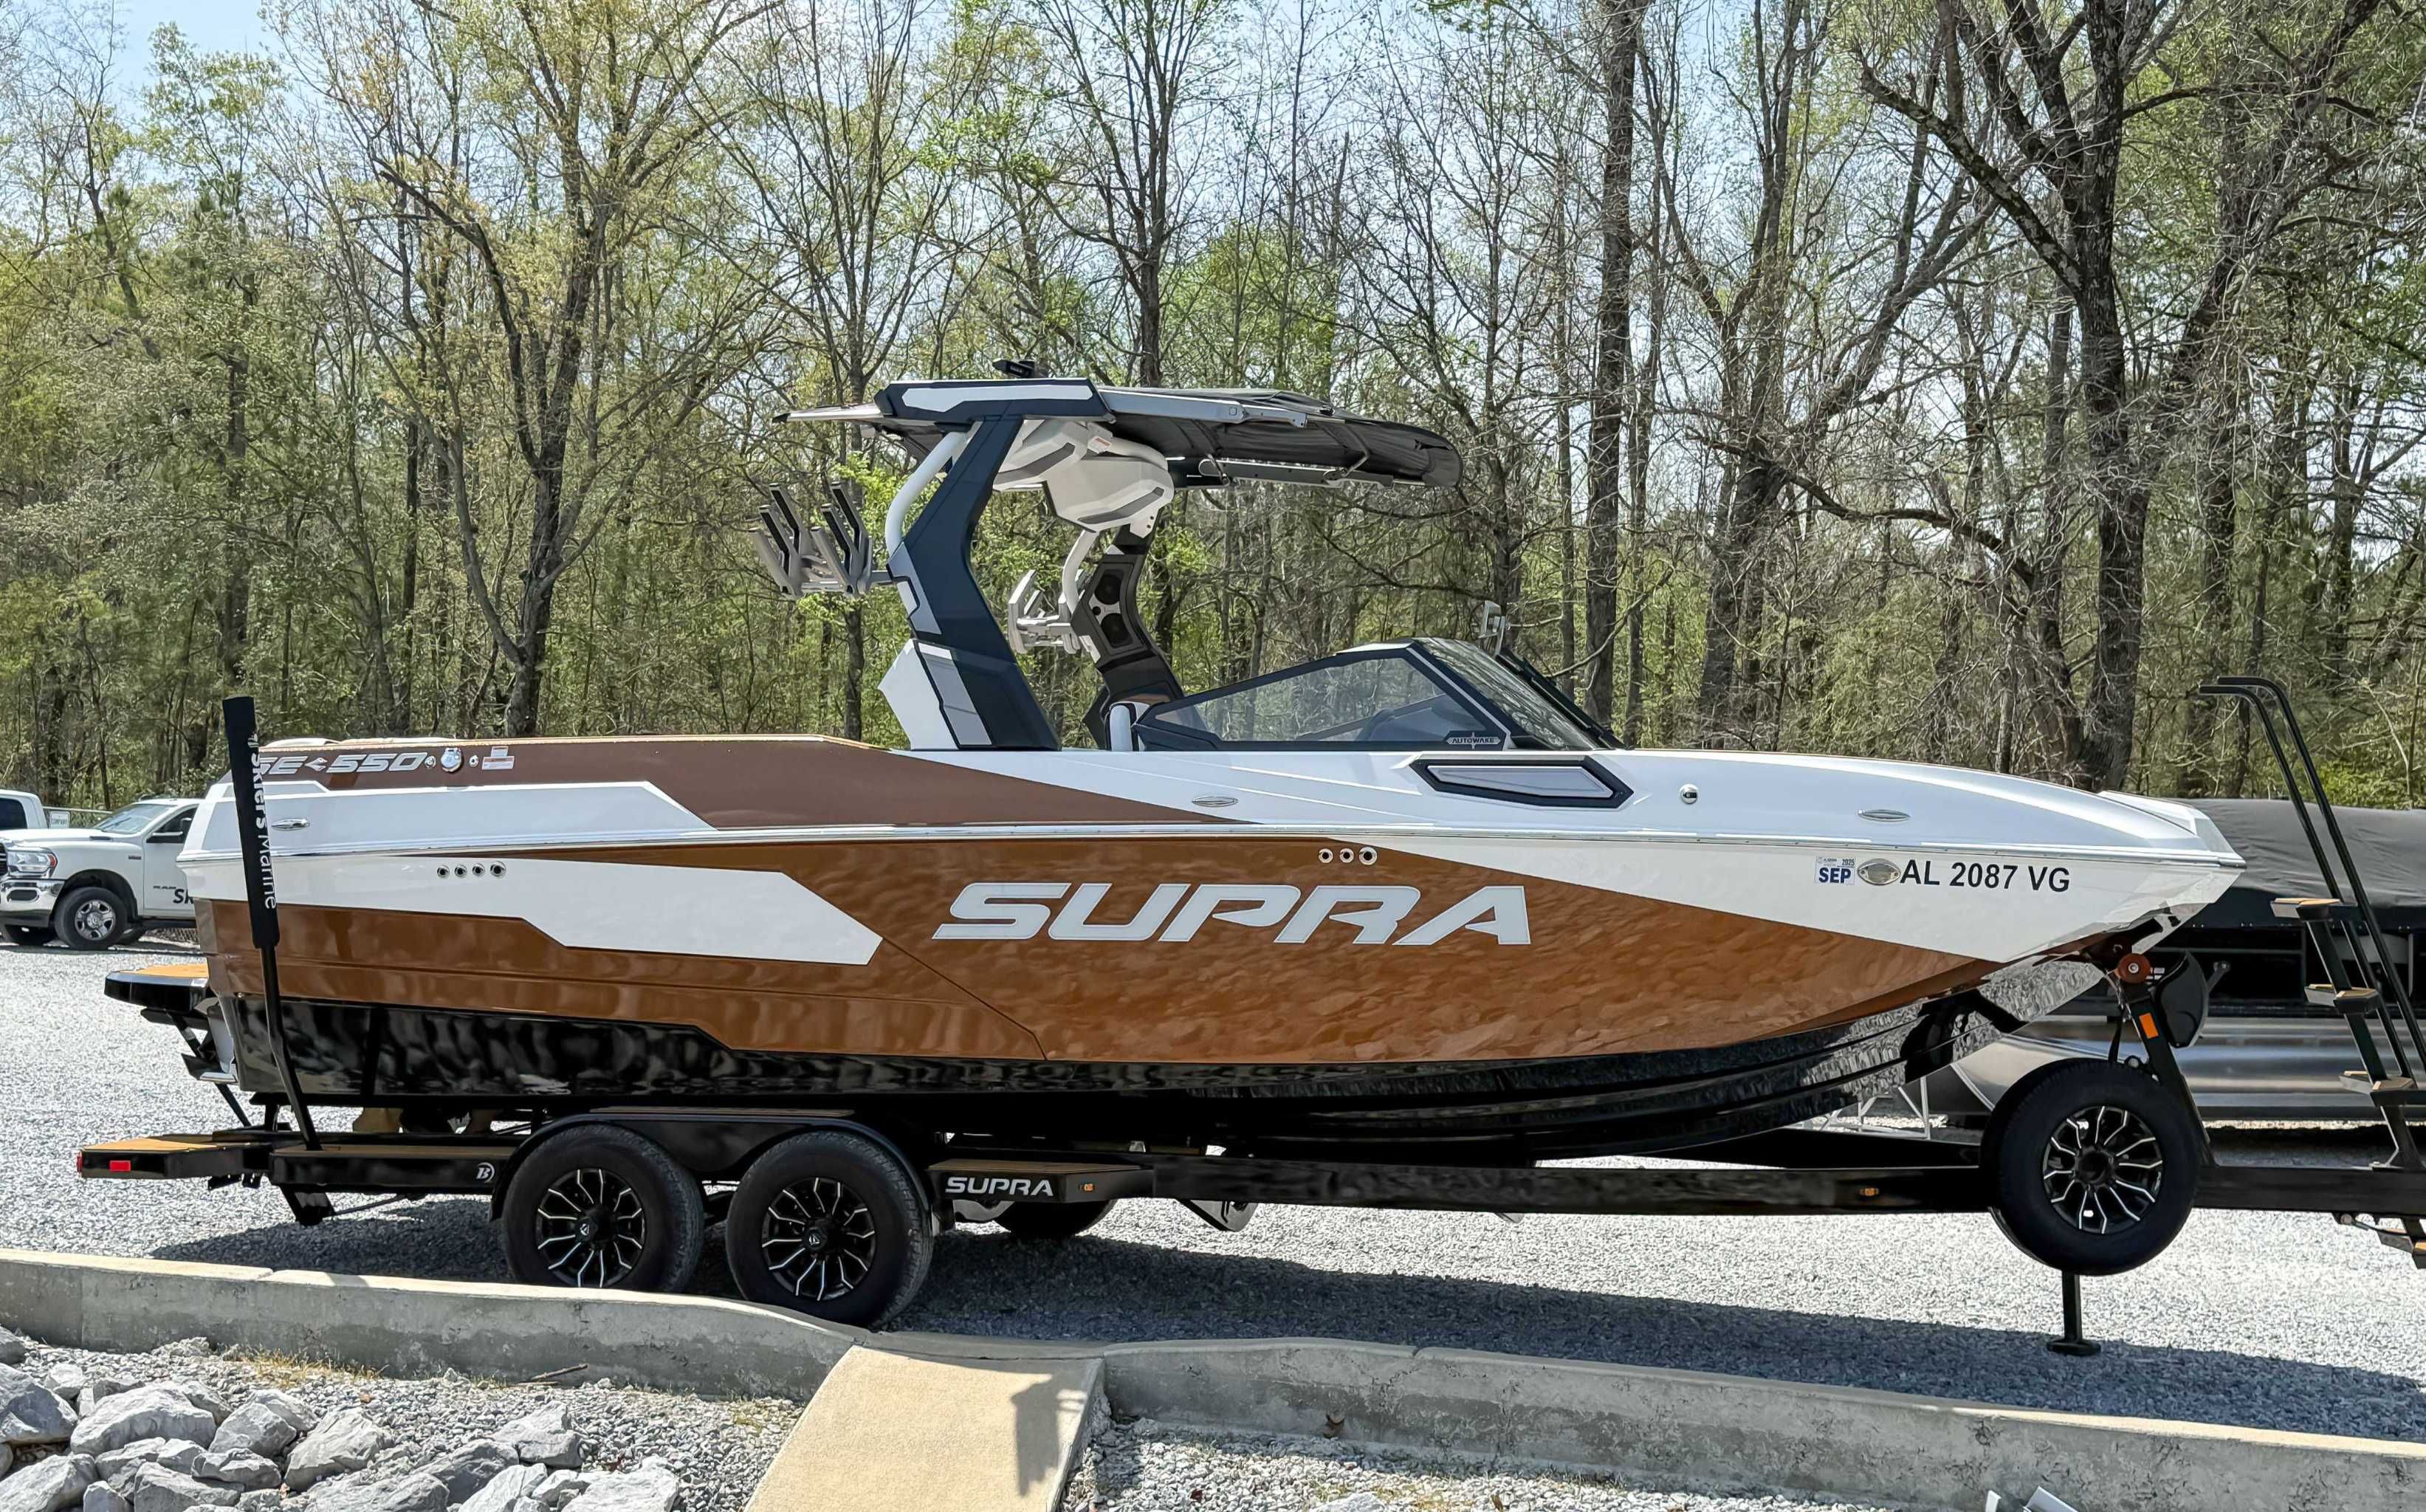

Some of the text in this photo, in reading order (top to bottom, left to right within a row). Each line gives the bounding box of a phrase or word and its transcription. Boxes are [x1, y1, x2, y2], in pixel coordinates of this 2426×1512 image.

[326, 752, 427, 773] 550
[258, 834, 277, 909] Marine
[1841, 858, 1855, 866] 2025
[1818, 867, 1852, 883] SEP
[1899, 859, 2070, 892] AL 2087 VG
[932, 882, 1531, 946] SUPRA
[945, 1177, 1054, 1197] SUPRA
